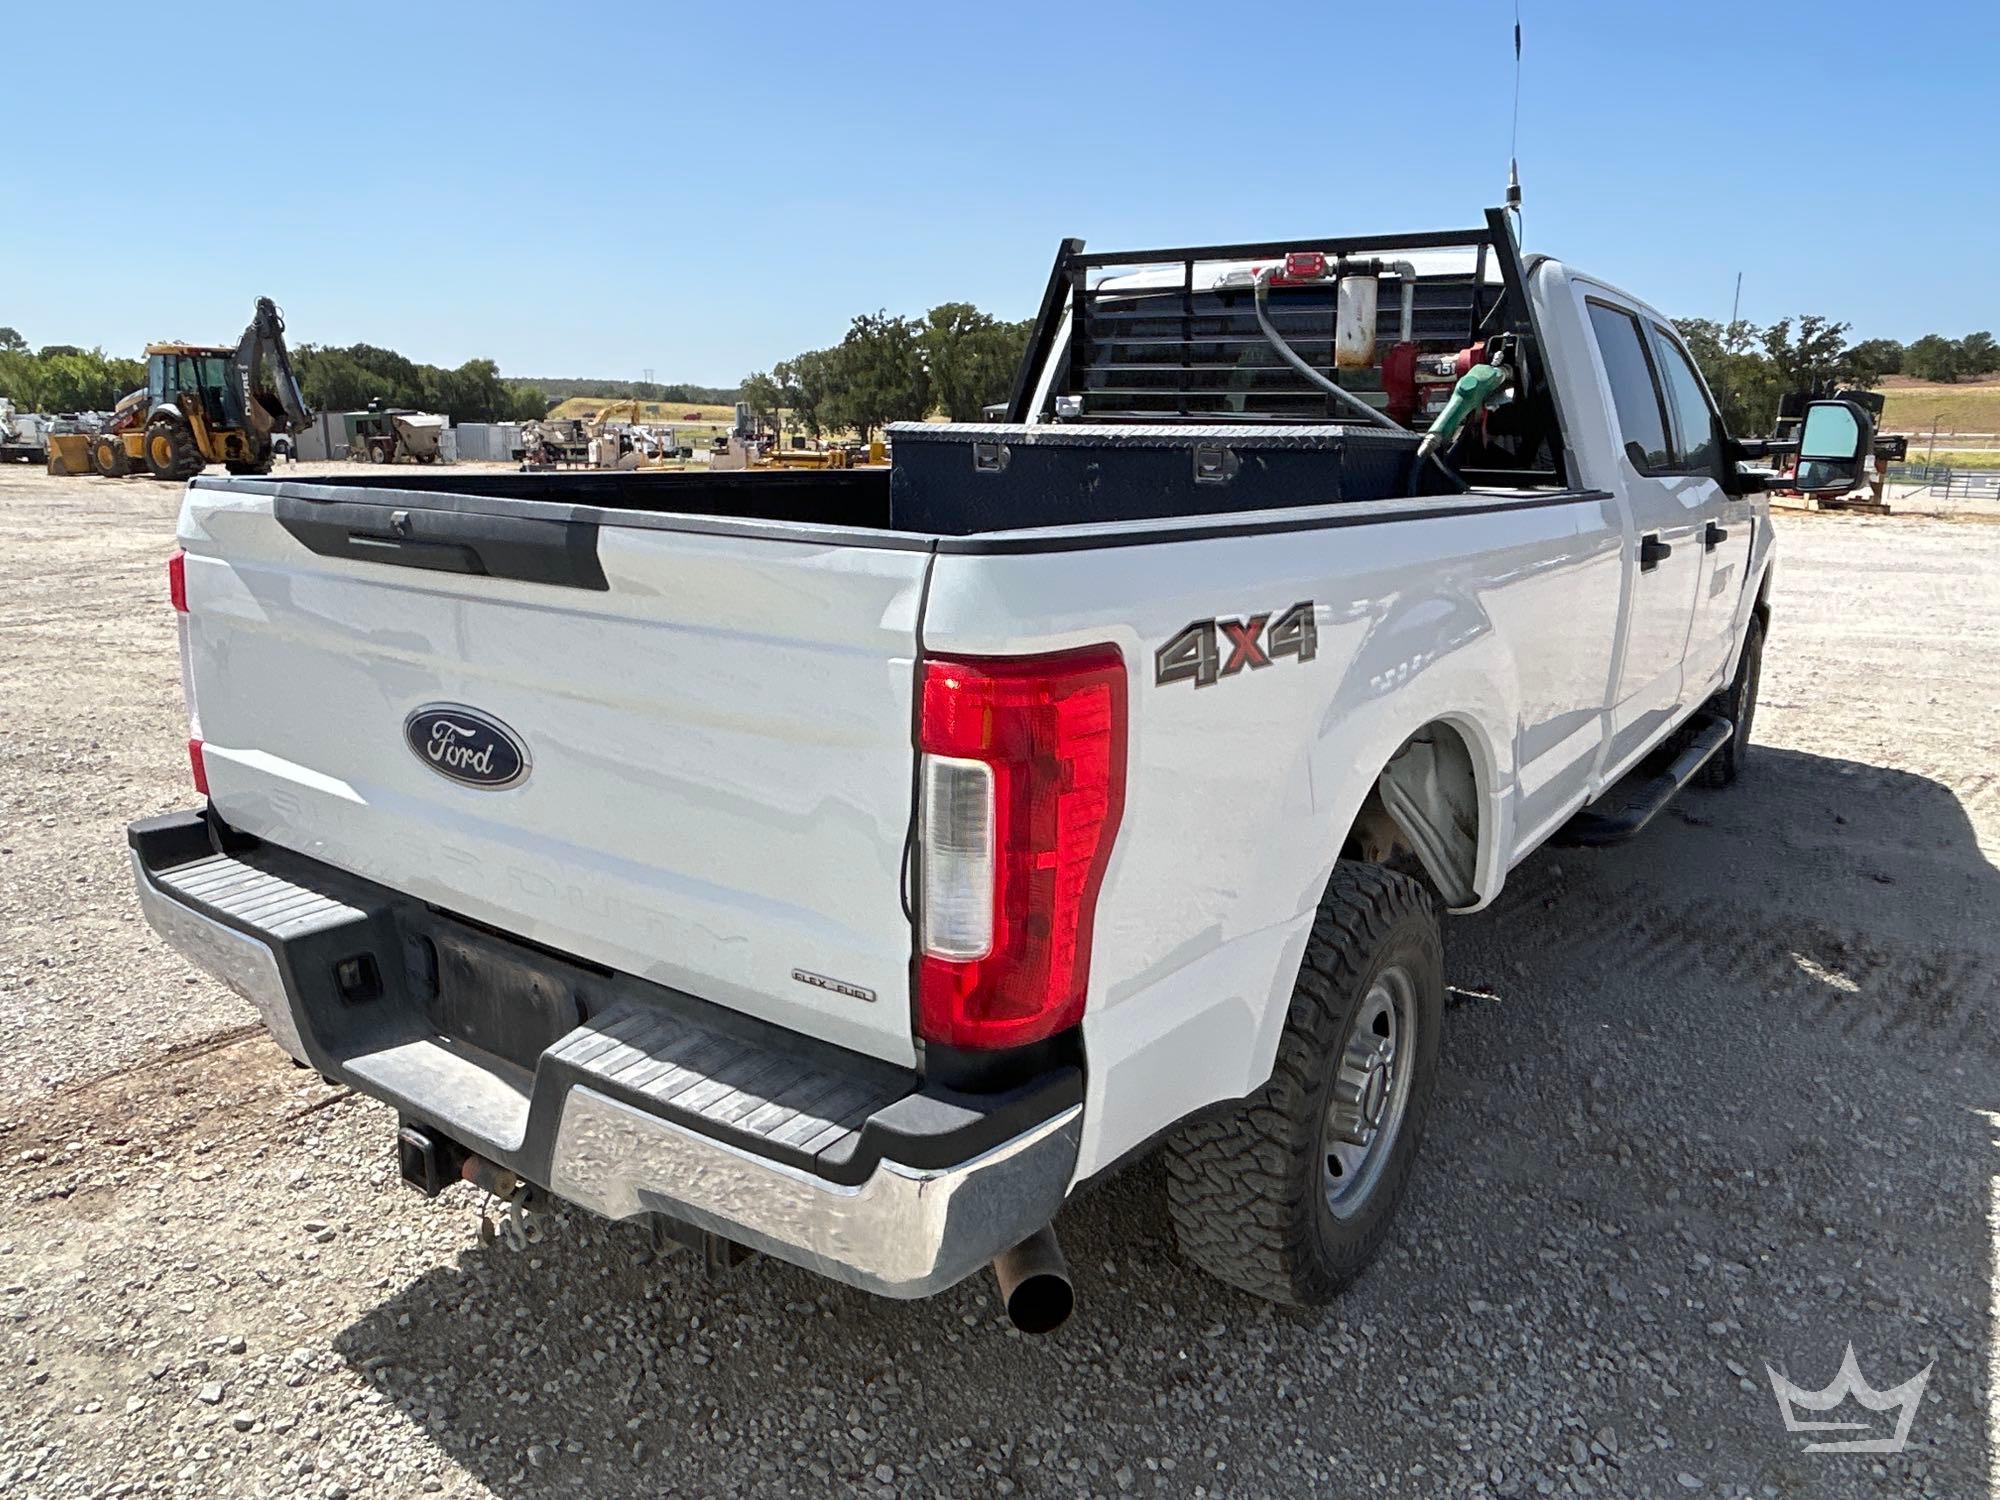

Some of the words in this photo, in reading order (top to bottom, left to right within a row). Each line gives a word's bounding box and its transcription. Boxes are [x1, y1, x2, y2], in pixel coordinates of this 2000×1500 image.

[241, 371, 251, 416] DEERE
[427, 720, 494, 775] Ford
[794, 972, 827, 989] FLEX
